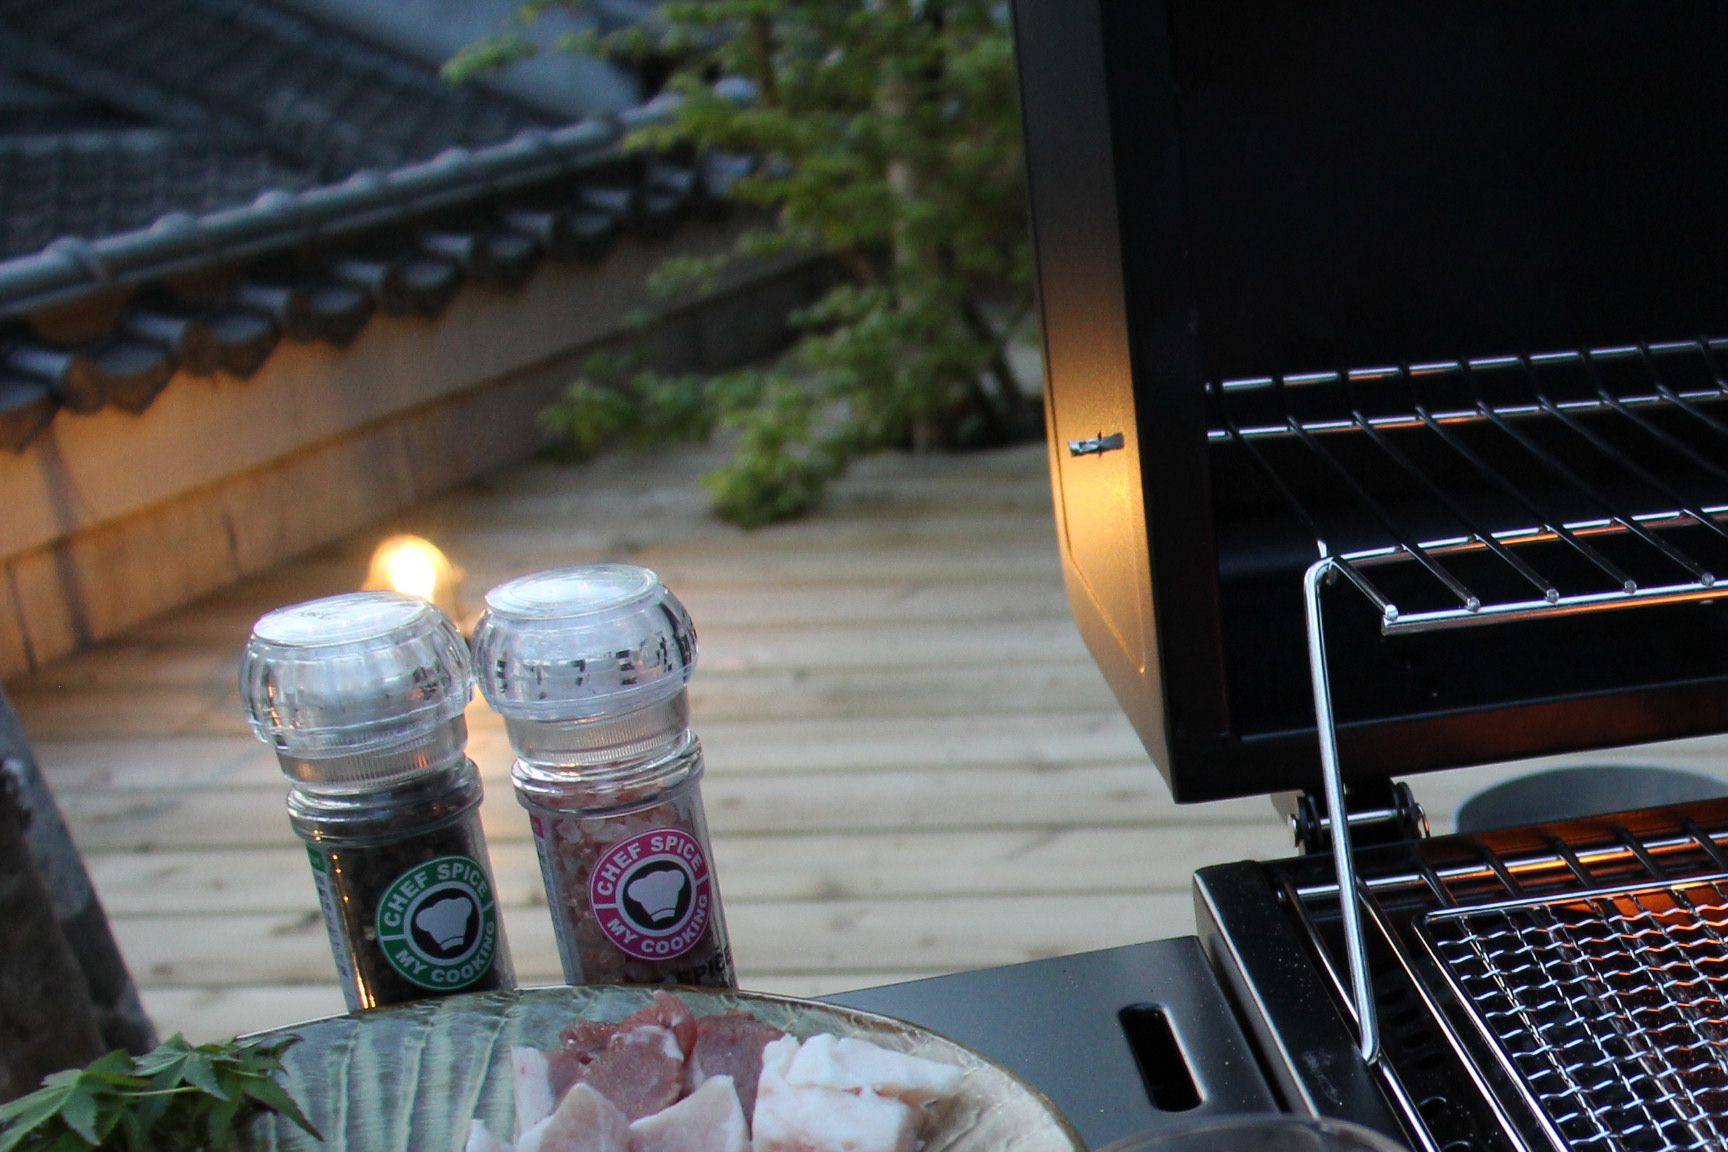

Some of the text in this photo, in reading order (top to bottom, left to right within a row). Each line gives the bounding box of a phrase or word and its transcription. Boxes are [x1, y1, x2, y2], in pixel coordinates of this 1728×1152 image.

[383, 870, 428, 927] CHEF
[437, 862, 488, 898] SPICE
[596, 842, 641, 896] CHEF
[650, 835, 703, 872] SPICE
[395, 920, 495, 983] MY COOKING
[607, 894, 707, 954] MY COOKING
